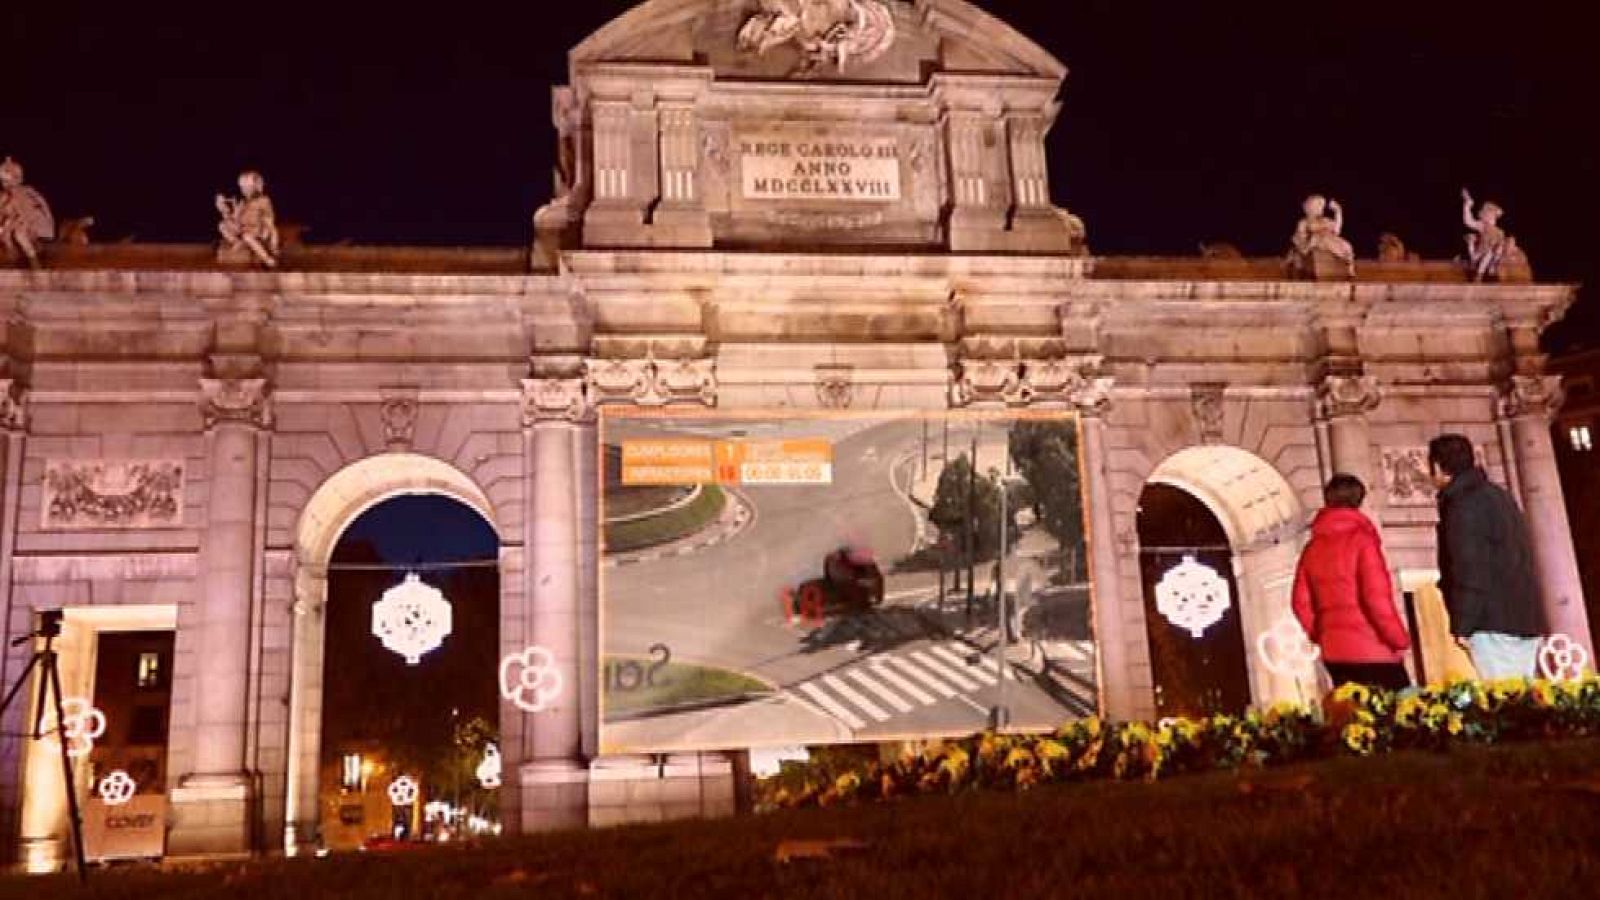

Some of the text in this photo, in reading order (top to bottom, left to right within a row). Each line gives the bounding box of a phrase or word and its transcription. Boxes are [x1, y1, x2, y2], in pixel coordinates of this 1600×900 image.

[740, 143, 790, 158] REGE
[797, 143, 873, 158] CAROLO
[793, 162, 851, 176] ANNO
[754, 178, 891, 195] MDCCLXXVIII
